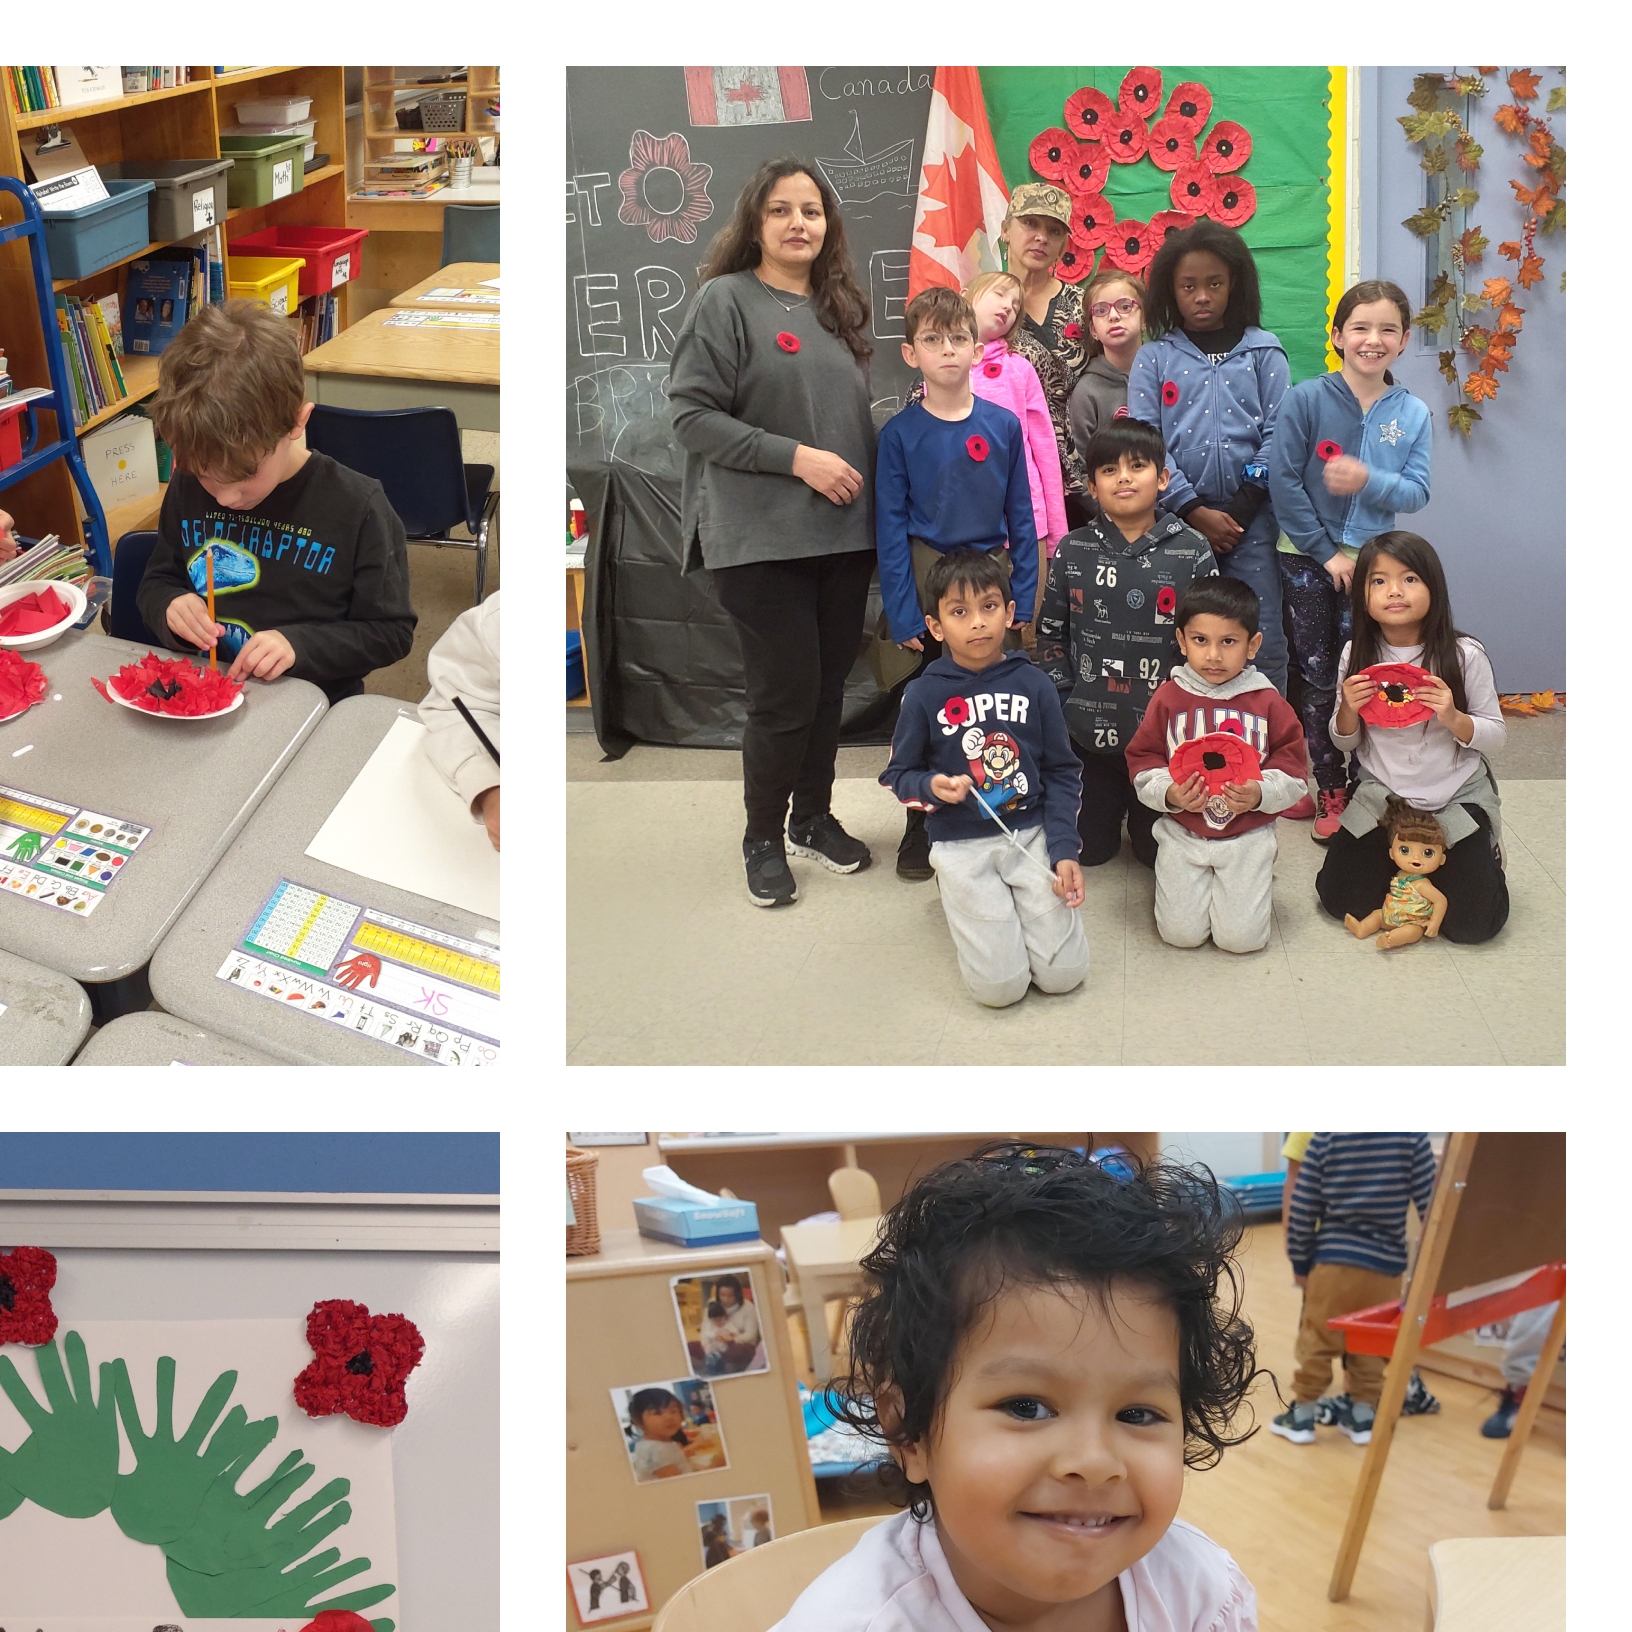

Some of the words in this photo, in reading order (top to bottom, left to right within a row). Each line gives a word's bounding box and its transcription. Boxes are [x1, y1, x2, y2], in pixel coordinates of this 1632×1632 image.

[819, 66, 935, 101] Canada
[274, 170, 289, 186] Math
[106, 442, 135, 460] PRESS
[111, 470, 137, 487] HERE
[1139, 658, 1161, 681] 92
[414, 987, 453, 1016] SK
